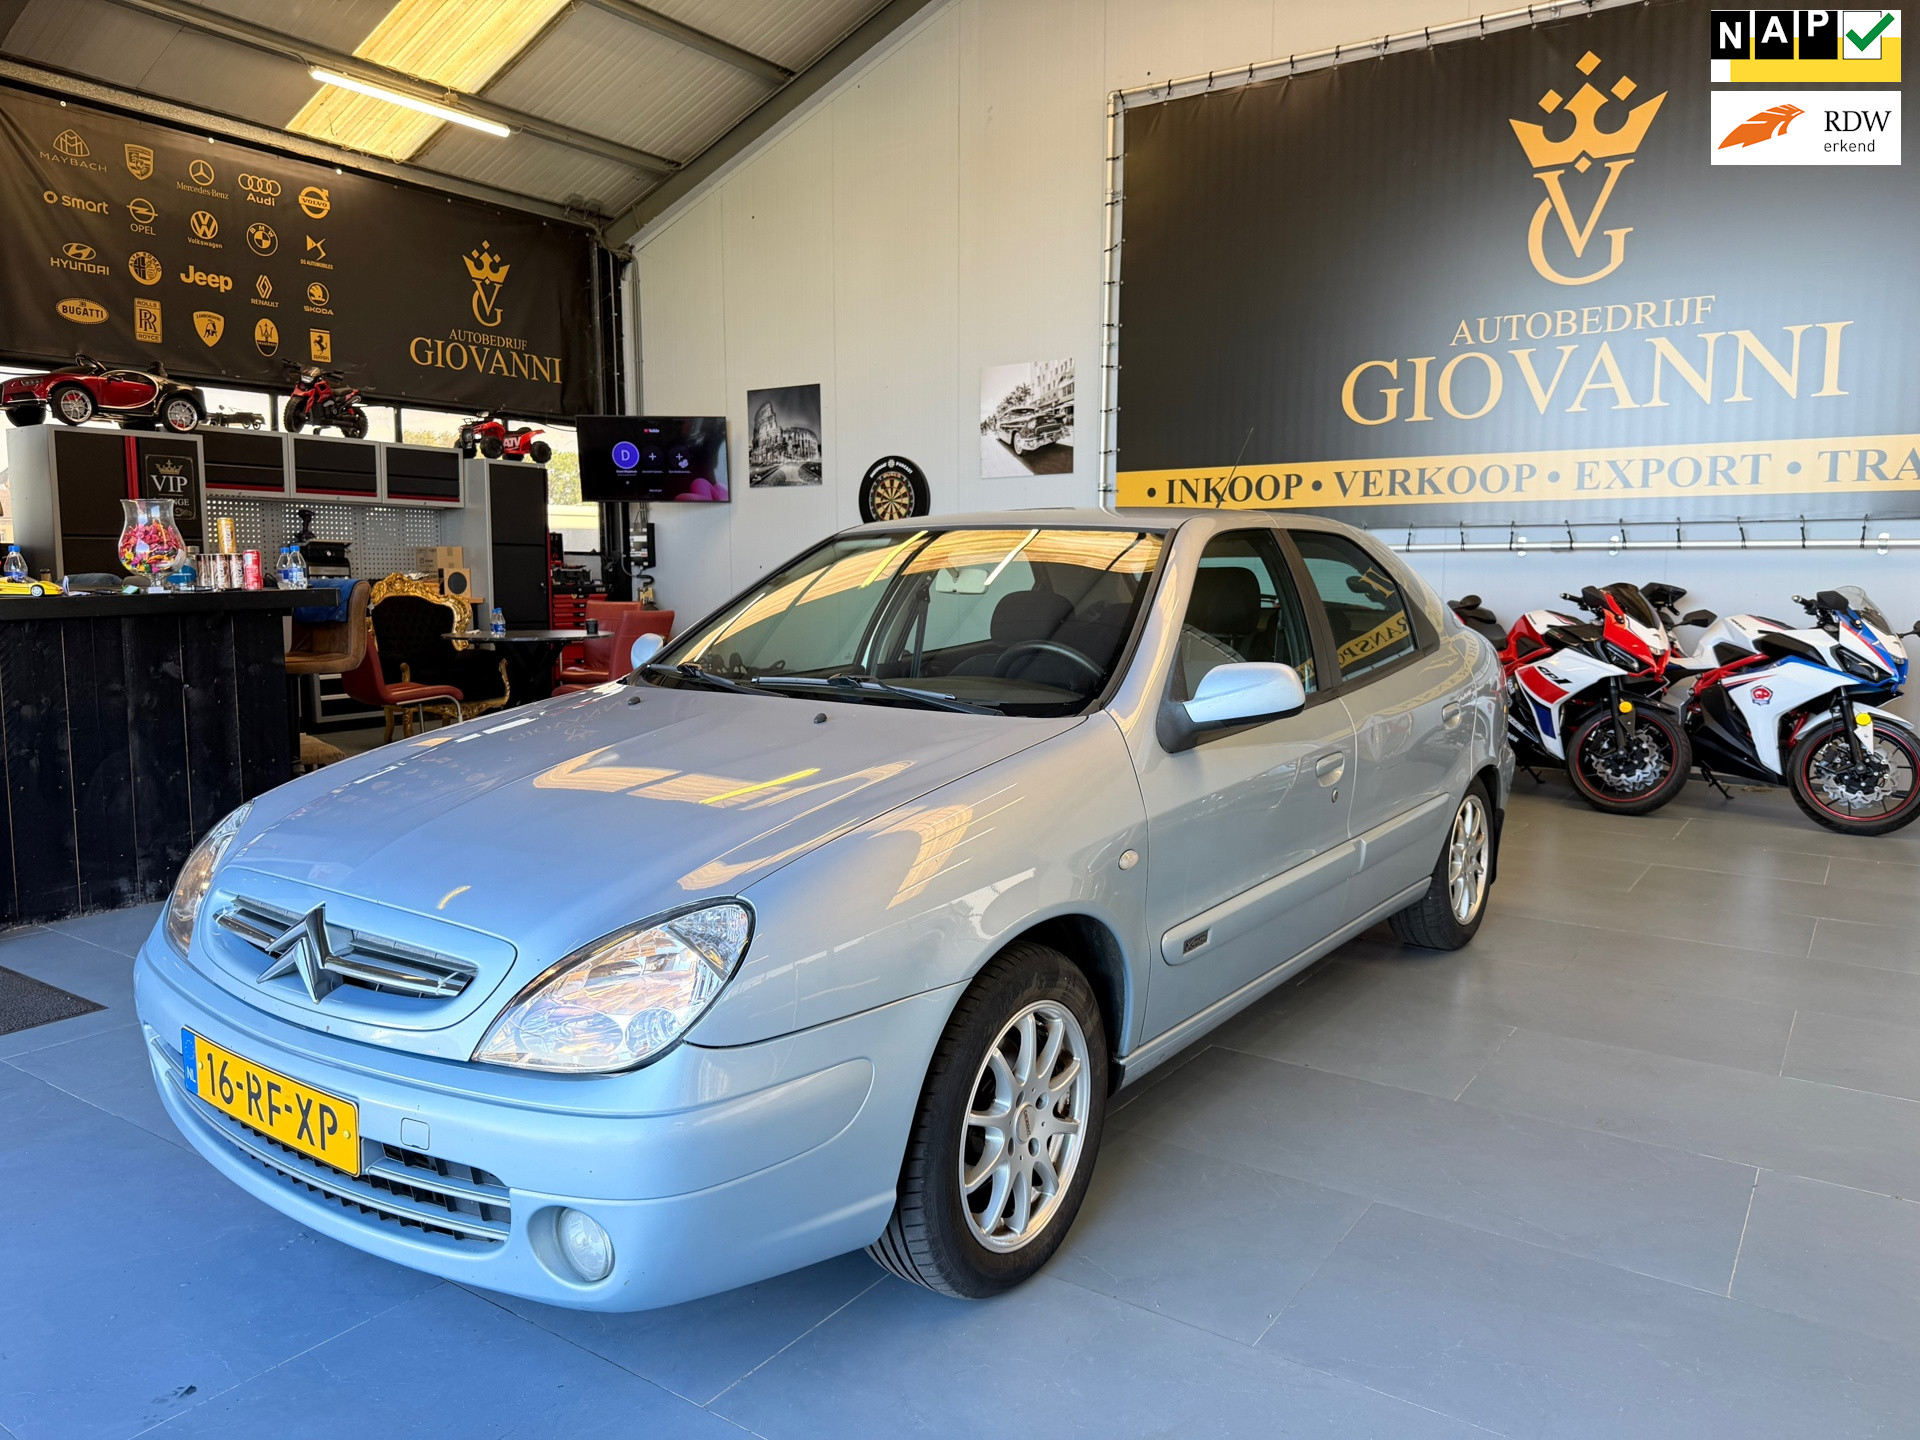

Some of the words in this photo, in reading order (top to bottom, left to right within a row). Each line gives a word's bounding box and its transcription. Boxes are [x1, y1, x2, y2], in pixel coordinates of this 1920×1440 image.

[40, 151, 107, 173] MAYBACH
[61, 195, 109, 215] smart
[247, 193, 275, 207] Audi
[302, 197, 328, 208] VOLVO
[130, 223, 156, 236] OPEL
[187, 236, 223, 249] Volkswagen
[50, 257, 110, 276] HYUNDAI
[179, 265, 233, 293] Jeep
[61, 305, 104, 319] BUGATTI
[251, 298, 279, 308] RENAULT
[1449, 295, 1716, 346] AUTOBEDRIJF
[449, 329, 528, 351] AUTOBEDRIJF
[410, 337, 563, 384] GIOVANNI
[1341, 320, 1854, 426] GIOVANNI
[503, 436, 521, 448] ATV
[621, 449, 630, 461] D
[151, 474, 188, 493] VIP
[1166, 474, 1303, 504] INKOOP
[1333, 463, 1537, 498] VERKOOP
[1575, 453, 1772, 491] EXPORT
[186, 1066, 197, 1083] NL
[207, 1052, 338, 1151] 16-RF-XP
